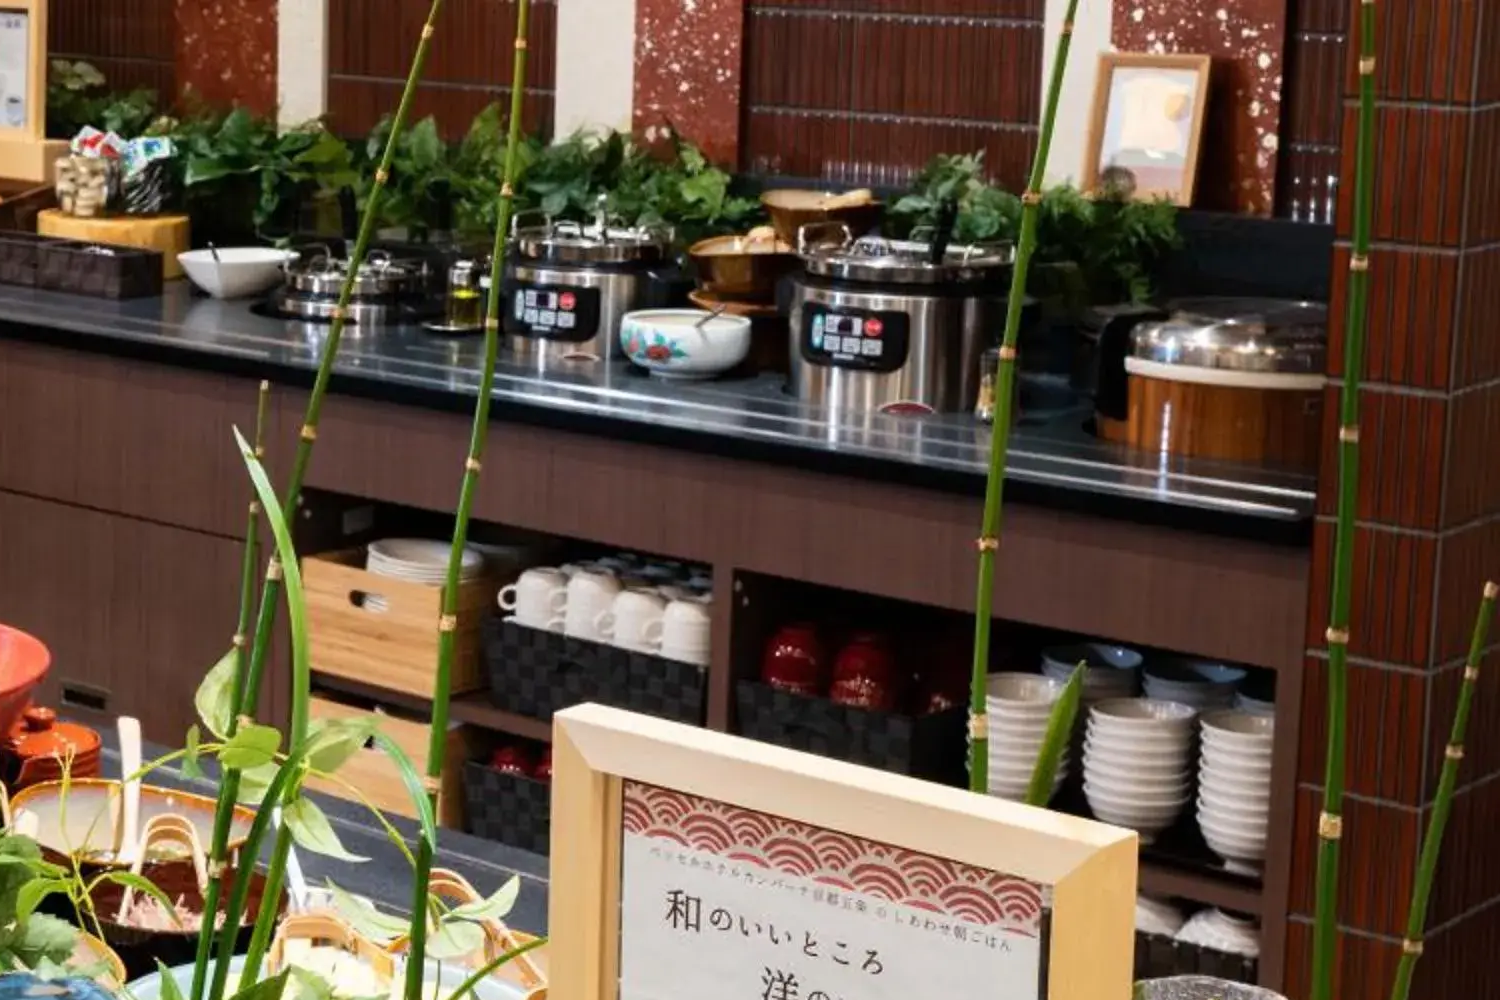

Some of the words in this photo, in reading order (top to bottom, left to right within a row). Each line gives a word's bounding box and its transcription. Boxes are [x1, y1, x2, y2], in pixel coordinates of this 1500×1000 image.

[666, 888, 885, 976] 和のいいところ
